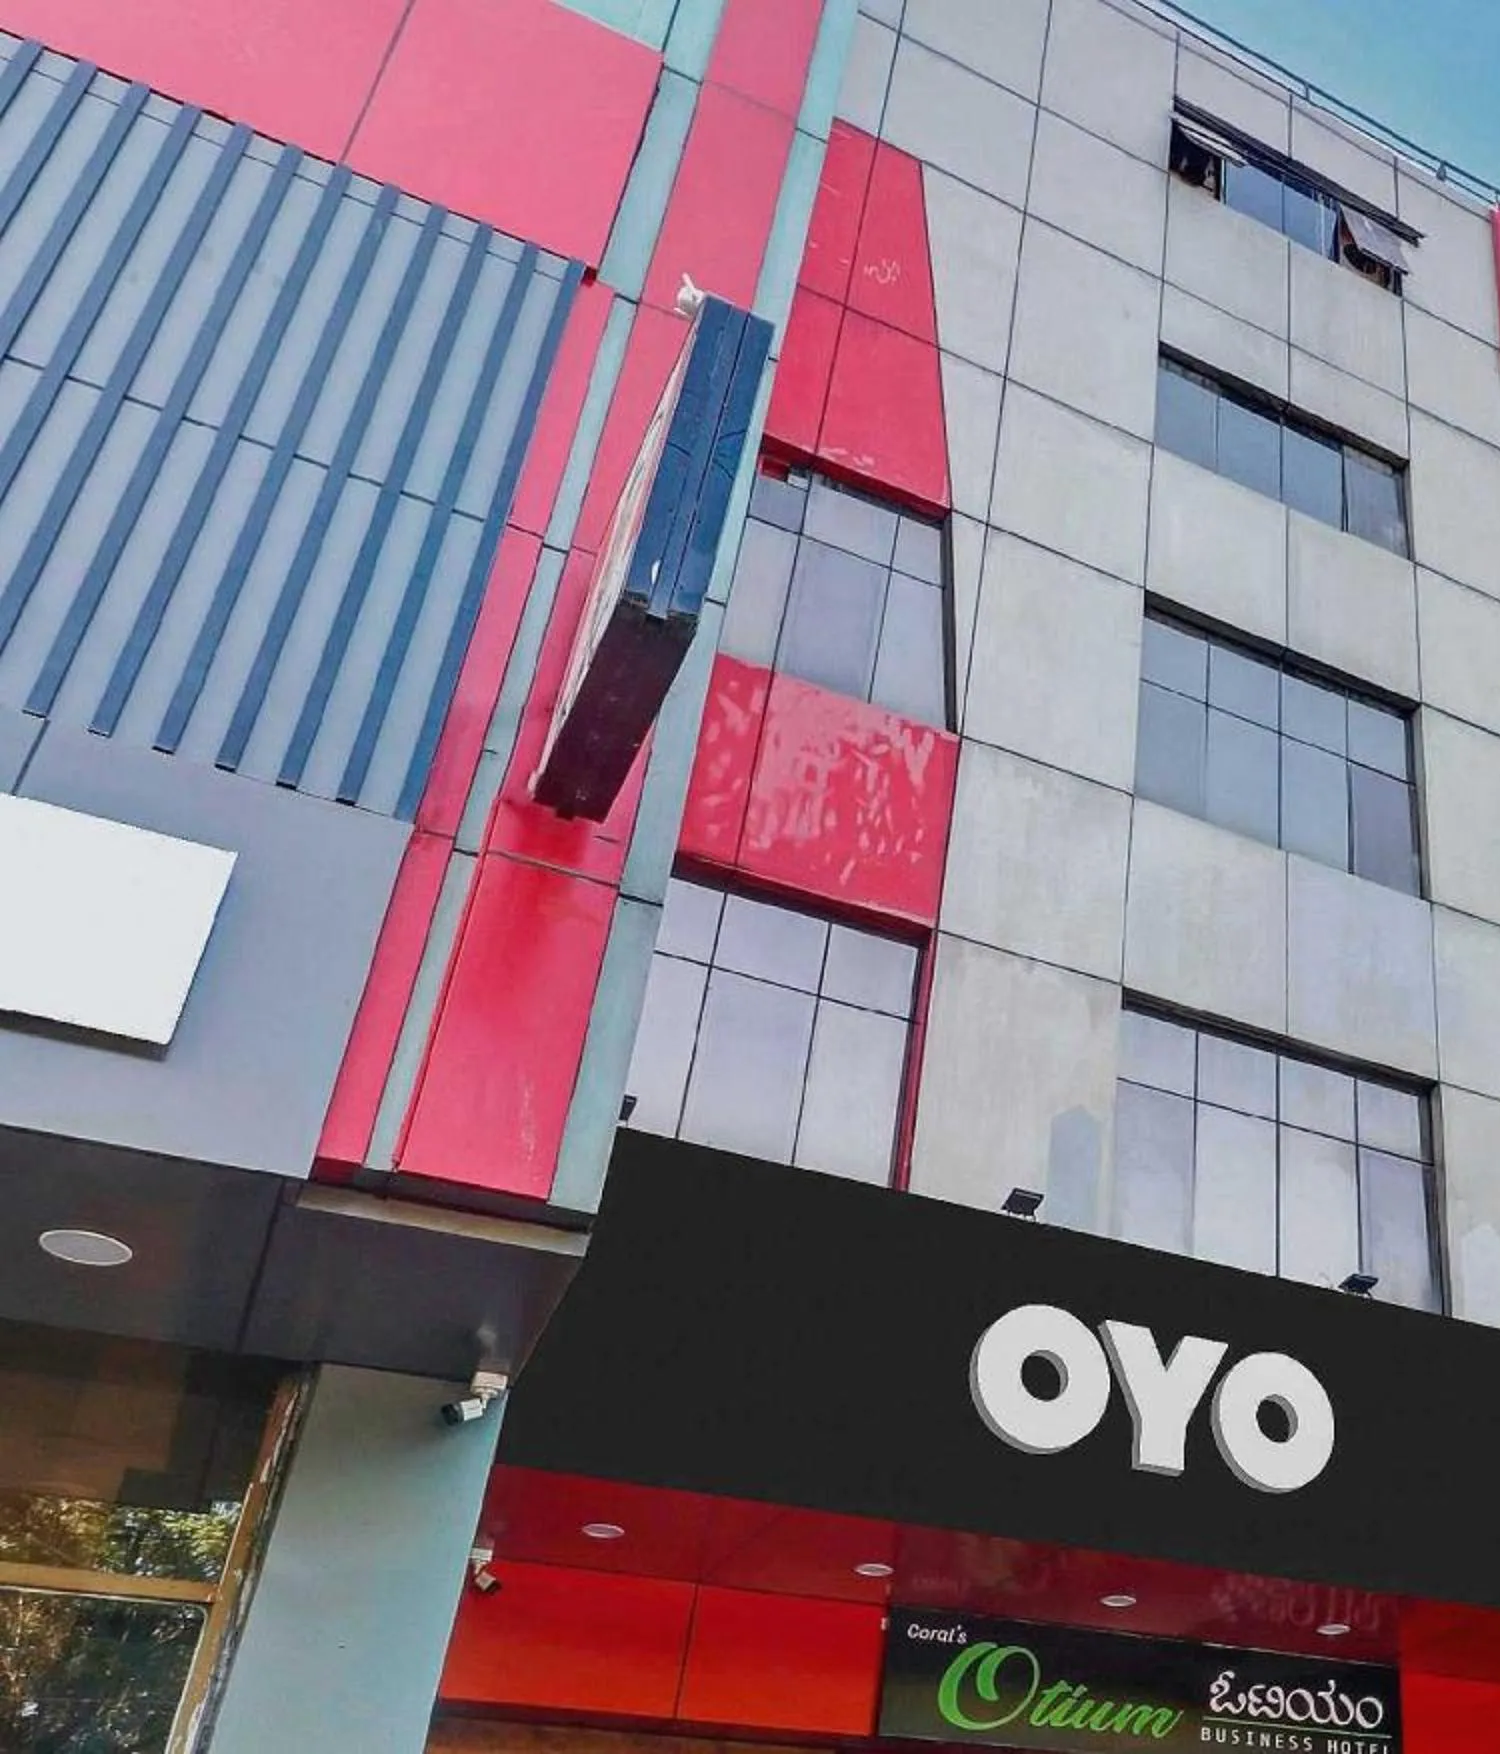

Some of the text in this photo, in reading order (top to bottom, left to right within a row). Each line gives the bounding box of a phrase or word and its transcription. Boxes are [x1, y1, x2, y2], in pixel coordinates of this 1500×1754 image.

[970, 1303, 1335, 1494] OYO
[907, 1623, 967, 1645] Coral's
[938, 1641, 1185, 1739] Otium
[1200, 1726, 1313, 1752] BUSINESS
